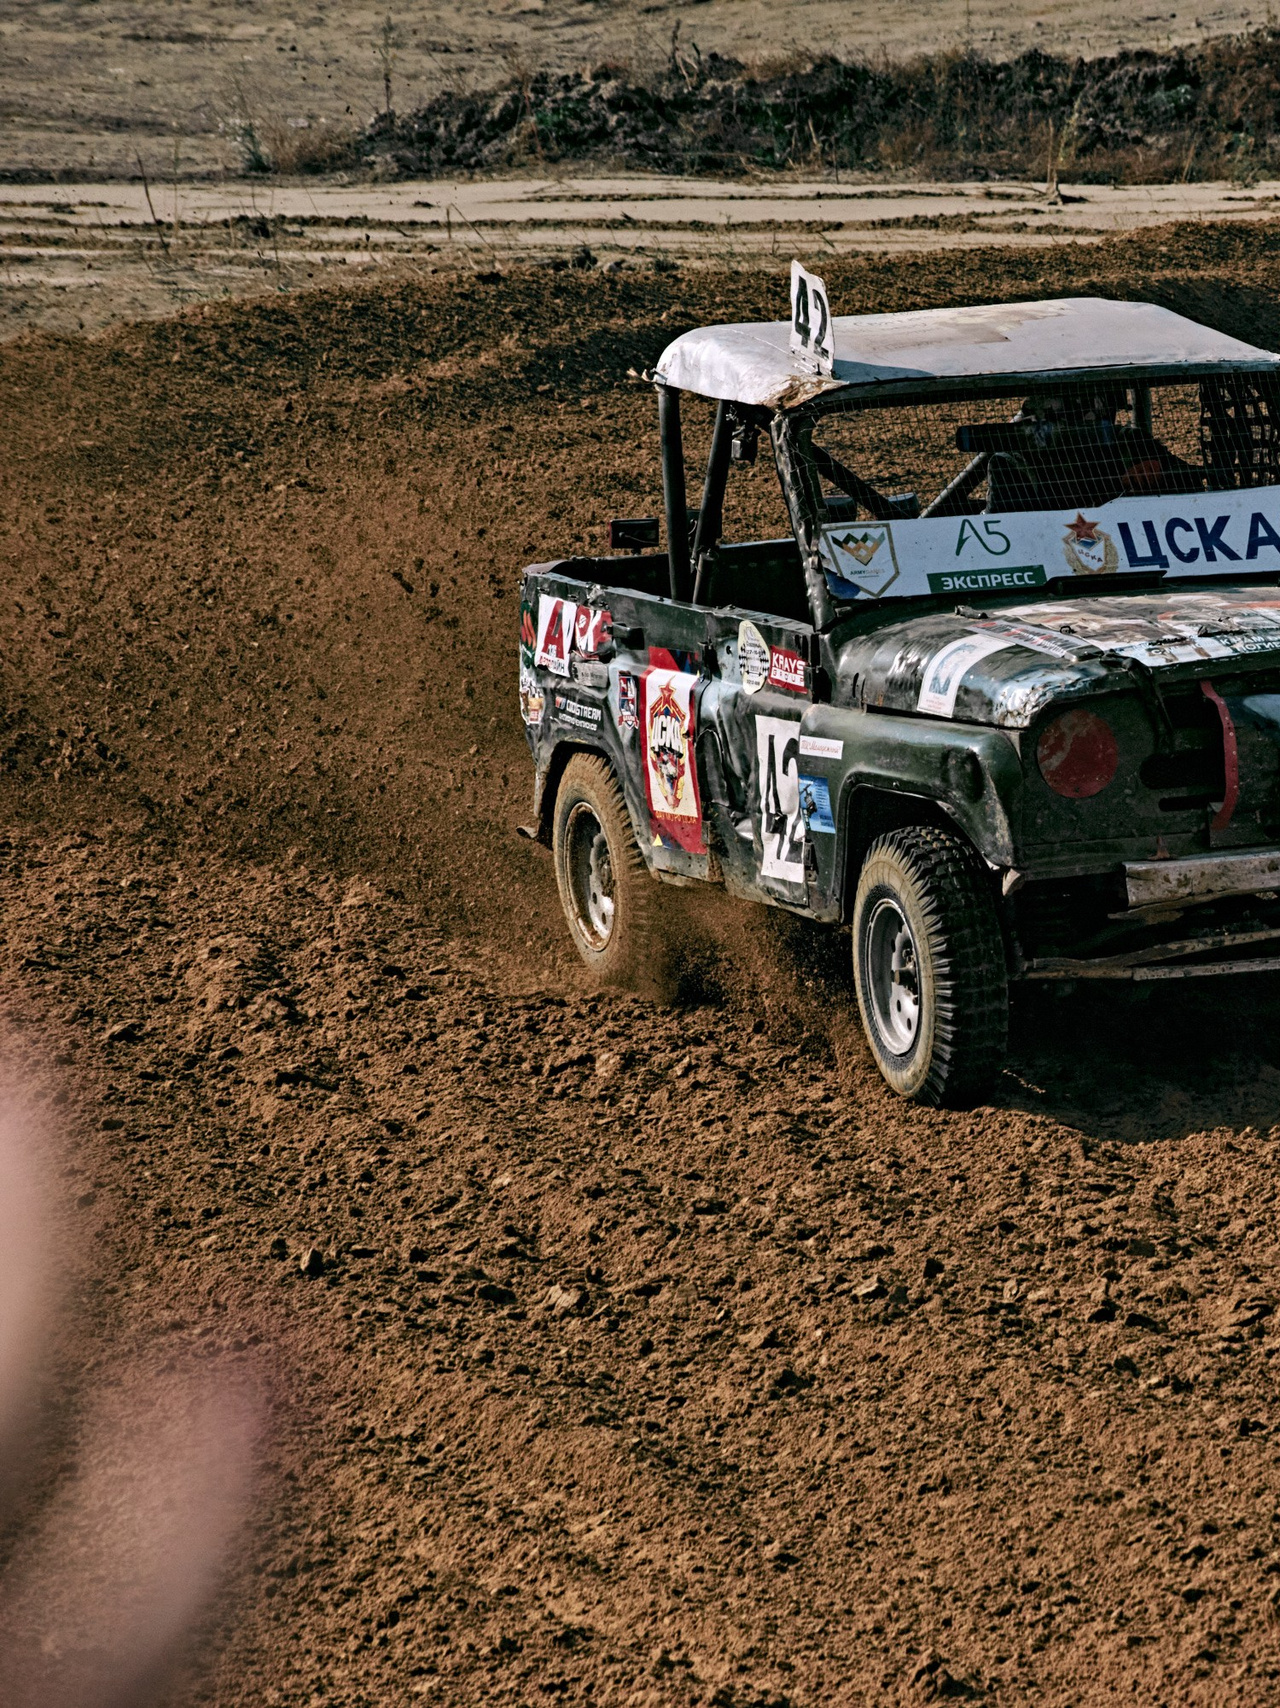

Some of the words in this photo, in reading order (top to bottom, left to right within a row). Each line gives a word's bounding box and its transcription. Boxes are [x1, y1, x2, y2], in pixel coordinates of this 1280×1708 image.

[795, 276, 829, 360] 42
[942, 571, 1036, 590] ЭКСПРЕСС
[772, 652, 806, 675] KRAYS
[652, 714, 684, 757] ЦСКА
[765, 734, 803, 864] 42
